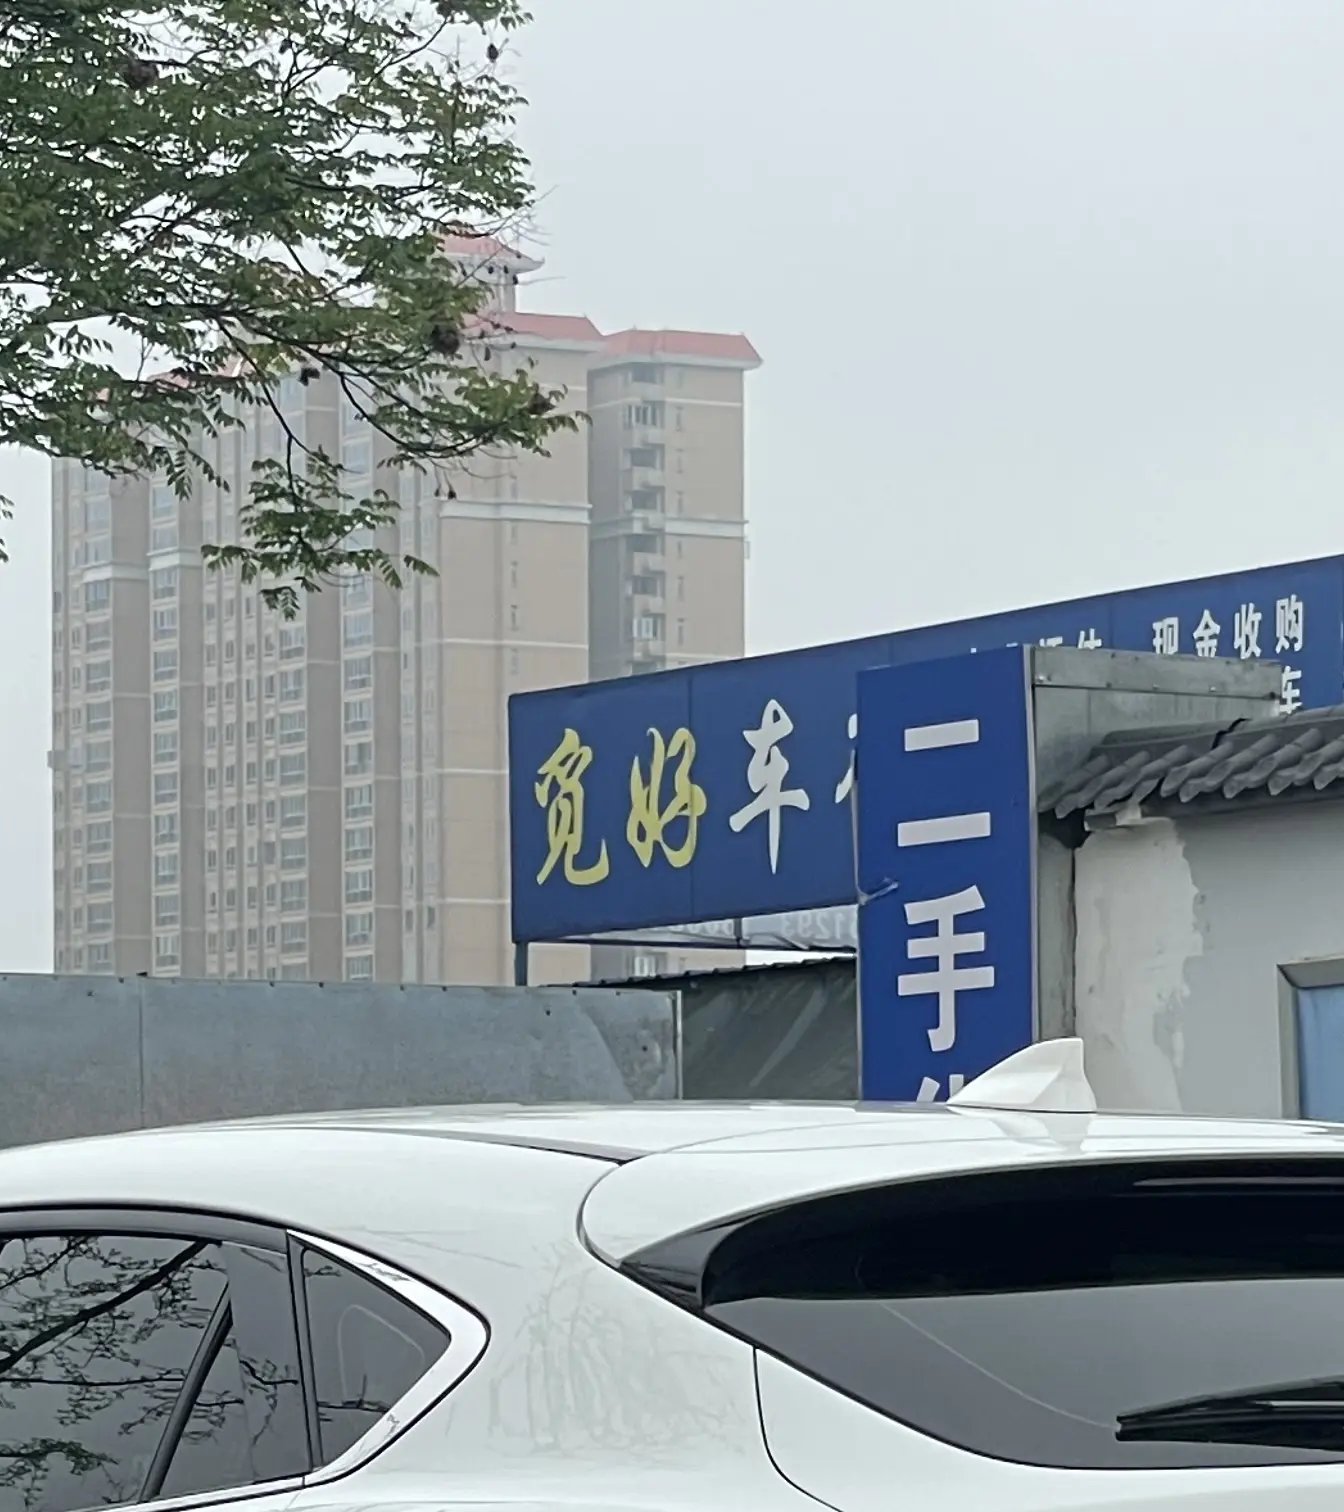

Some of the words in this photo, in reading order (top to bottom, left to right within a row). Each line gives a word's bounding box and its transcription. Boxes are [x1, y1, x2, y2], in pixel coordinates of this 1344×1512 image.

[1152, 593, 1304, 659] 现金收购
[534, 699, 857, 886] 觅好车
[897, 718, 995, 1102] 二手
